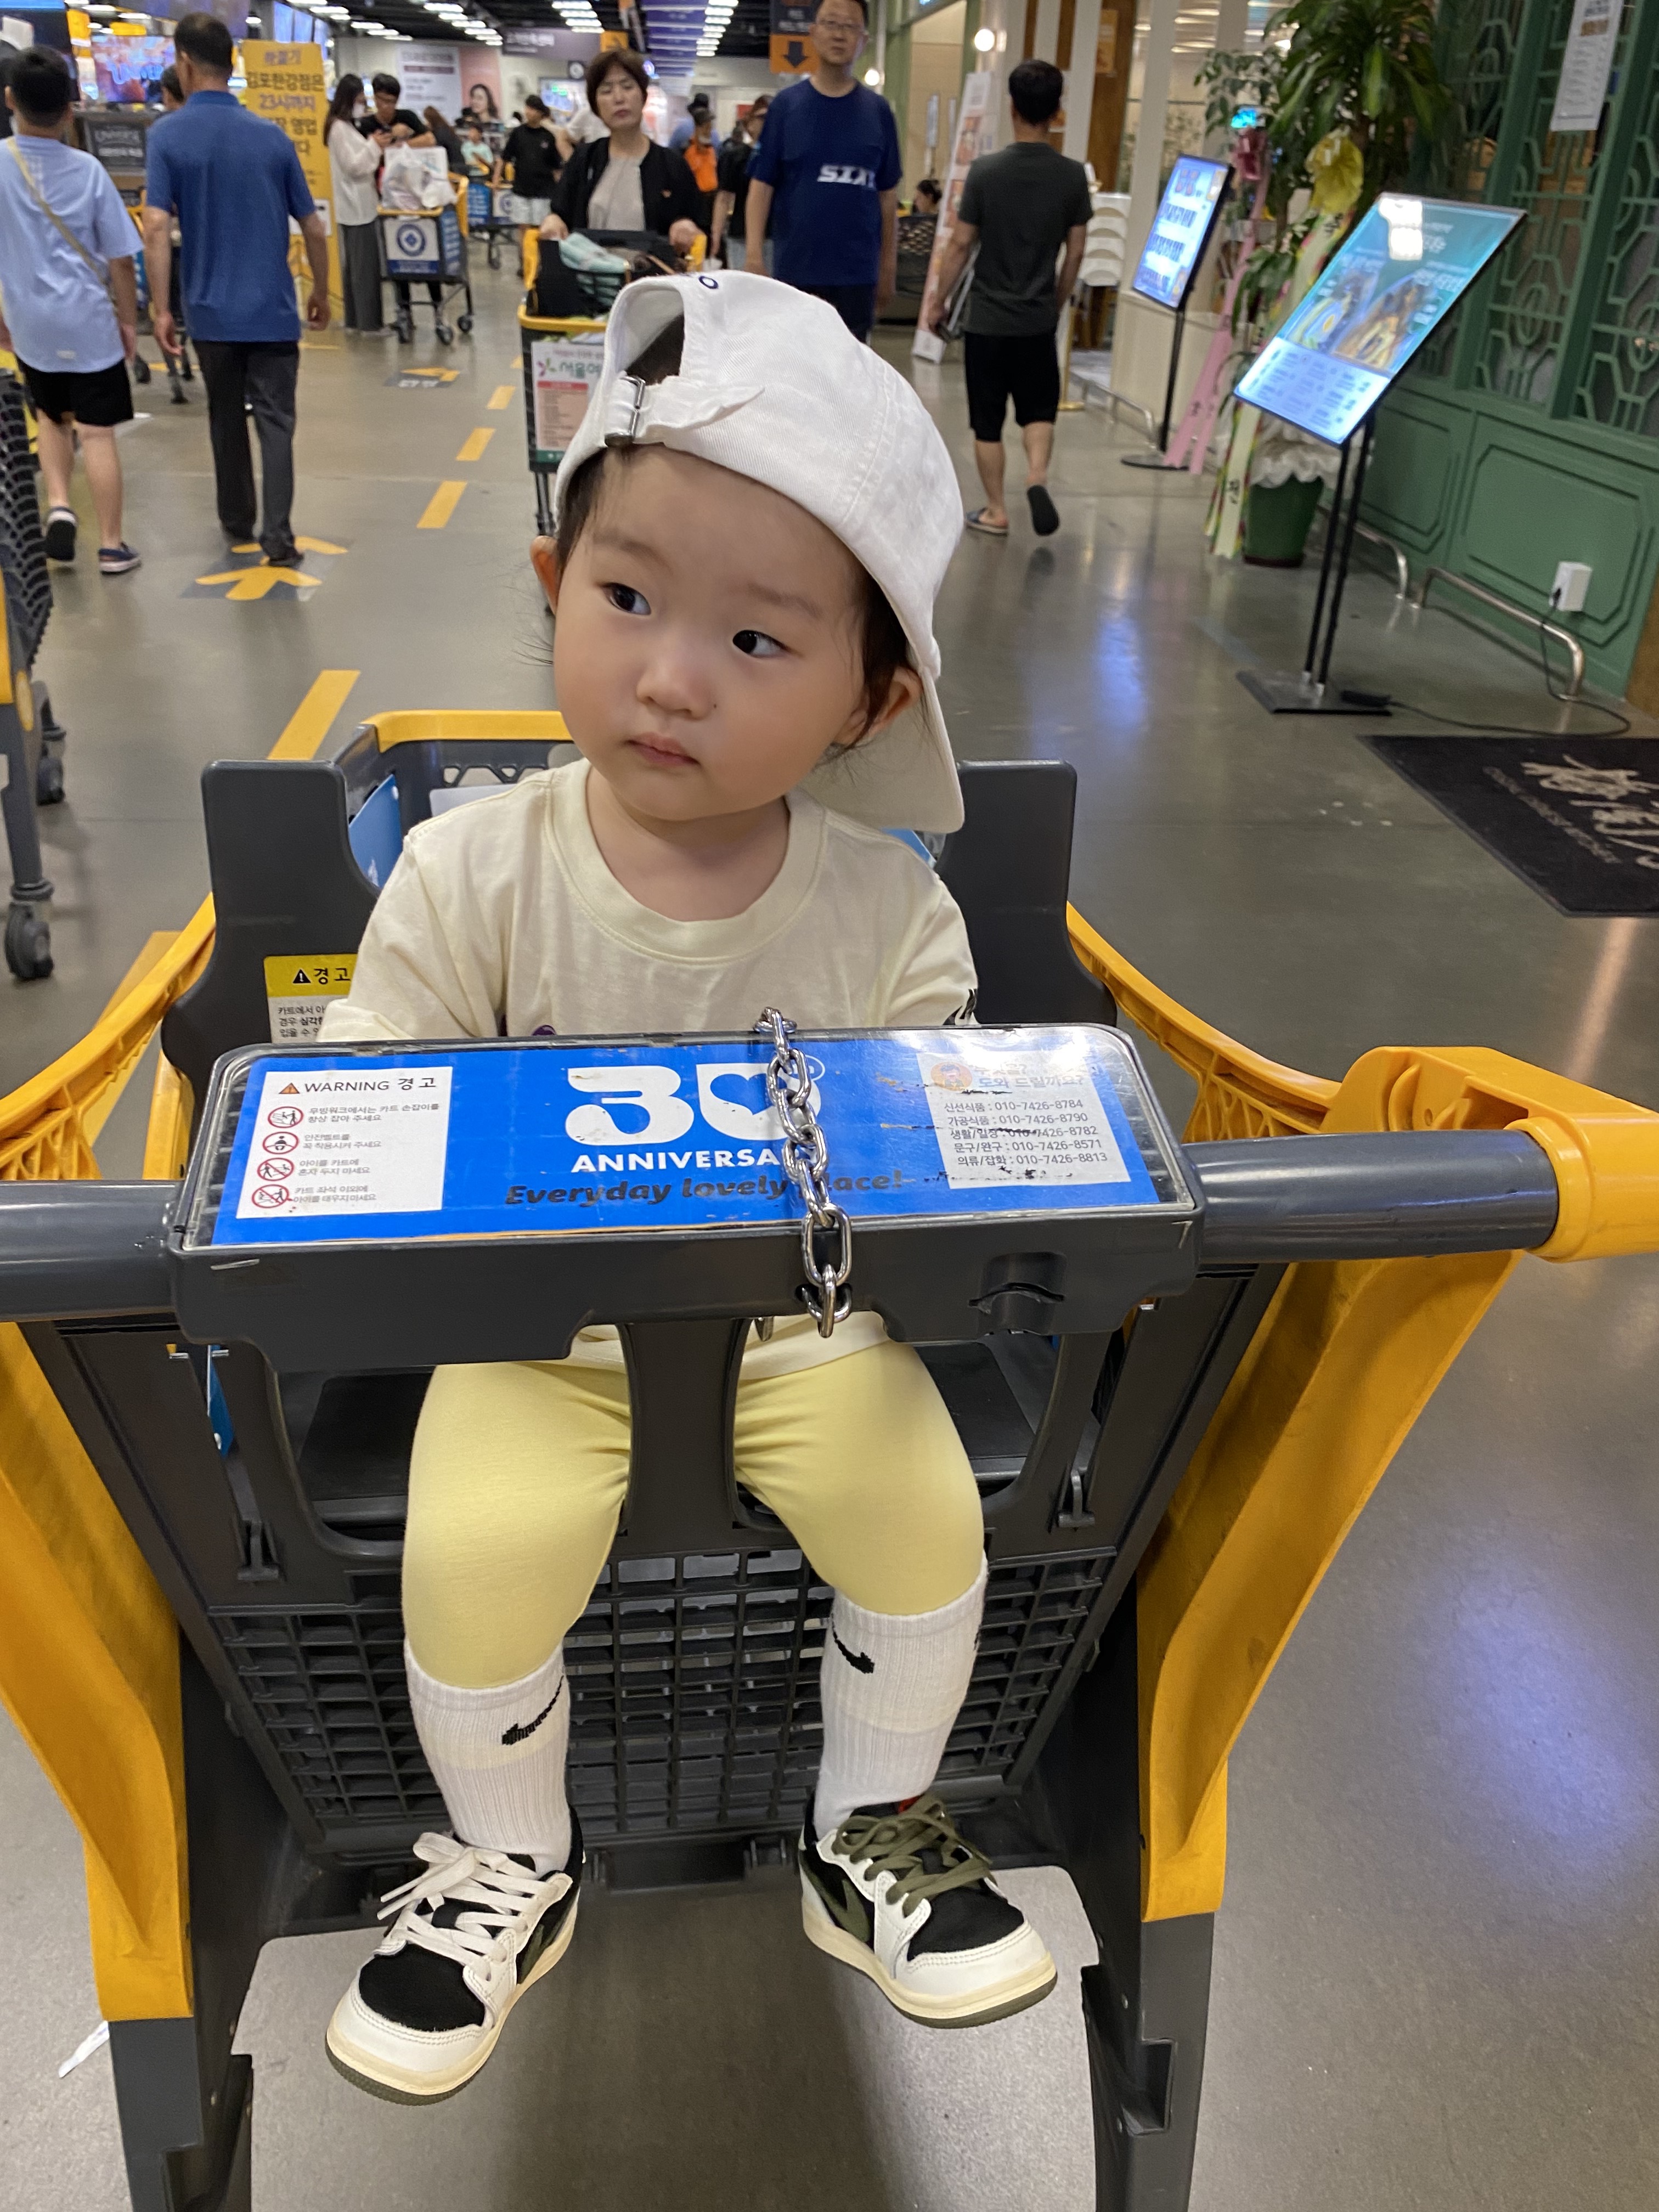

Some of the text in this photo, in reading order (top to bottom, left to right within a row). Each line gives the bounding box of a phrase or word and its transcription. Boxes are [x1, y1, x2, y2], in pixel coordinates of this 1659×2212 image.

[313, 967, 351, 985] 경고
[278, 1006, 313, 1014] 카트에서
[279, 1017, 297, 1026] 경우
[280, 1028, 297, 1037] 입을
[301, 1028, 310, 1036] 수
[304, 1077, 437, 1092] WARNING 경고
[978, 1075, 1084, 1088] 도와 드릴까요?
[309, 1106, 376, 1115] 무빙워크에서는
[402, 1103, 439, 1111] 손잡이를
[565, 1062, 822, 1146] 30
[944, 1103, 986, 1113] 신선식품
[995, 1099, 1084, 1110] 010-7426-8784
[947, 1116, 989, 1126] 가공식품
[999, 1112, 1088, 1124] 010-7426-8790
[954, 1142, 1002, 1153] 문구/완구
[1012, 1139, 1102, 1151] 010-7426-8571
[571, 1144, 817, 1173] ANNIVERSA
[957, 1155, 1007, 1166] 의류/잡화
[1016, 1152, 1108, 1164] 010-7426-8813
[505, 1169, 902, 1208] Everyday lovely lace!
[294, 1195, 320, 1203] 아이를
[349, 1193, 377, 1201] 마세요
